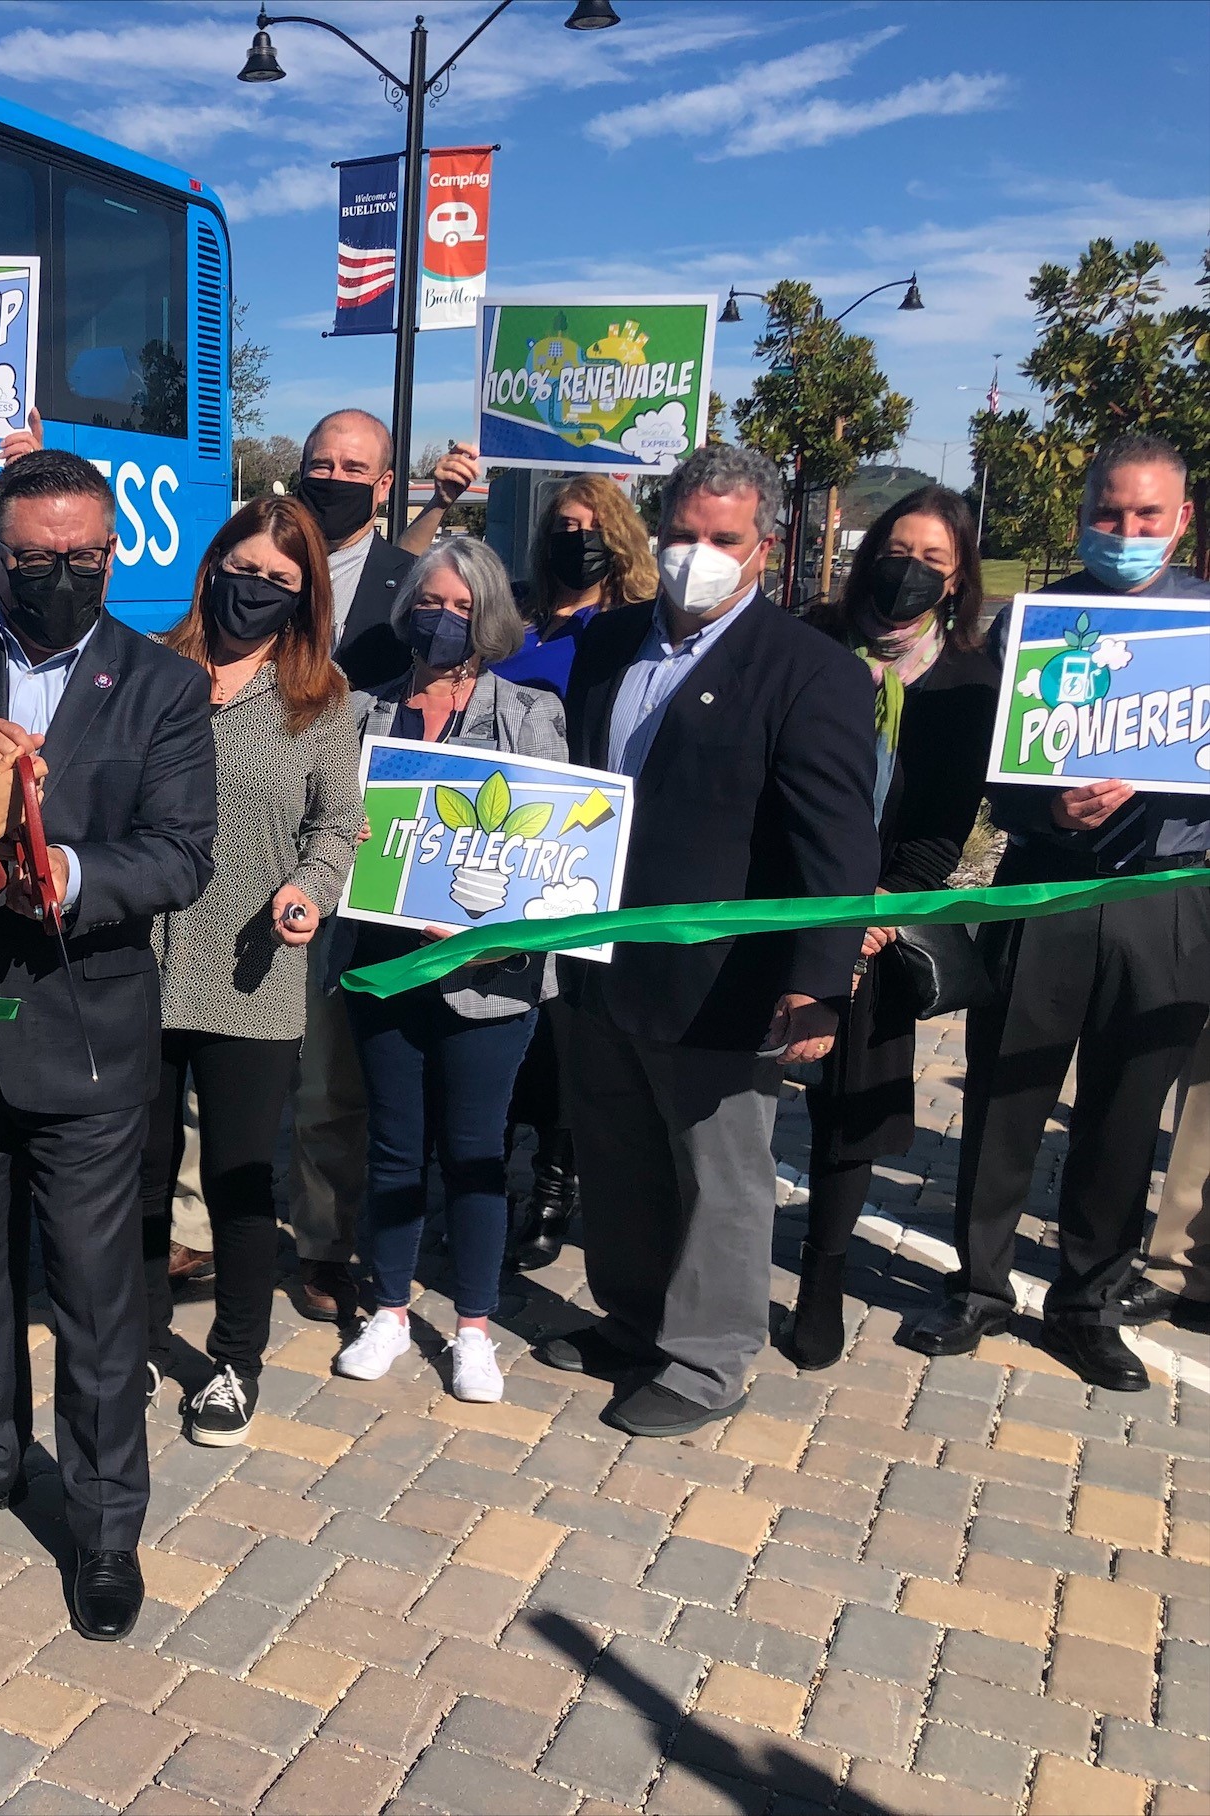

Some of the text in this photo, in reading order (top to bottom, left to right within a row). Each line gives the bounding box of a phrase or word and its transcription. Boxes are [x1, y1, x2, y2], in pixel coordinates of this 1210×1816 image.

[429, 171, 490, 189] Camping
[355, 191, 396, 203] Welcome to
[341, 201, 396, 217] BUELLTON
[487, 360, 695, 405] 100% RENEWABLE
[640, 440, 682, 448] EXPRESS
[1018, 683, 1210, 766] POWERED
[381, 817, 589, 887] IT'S ELECTRIC
